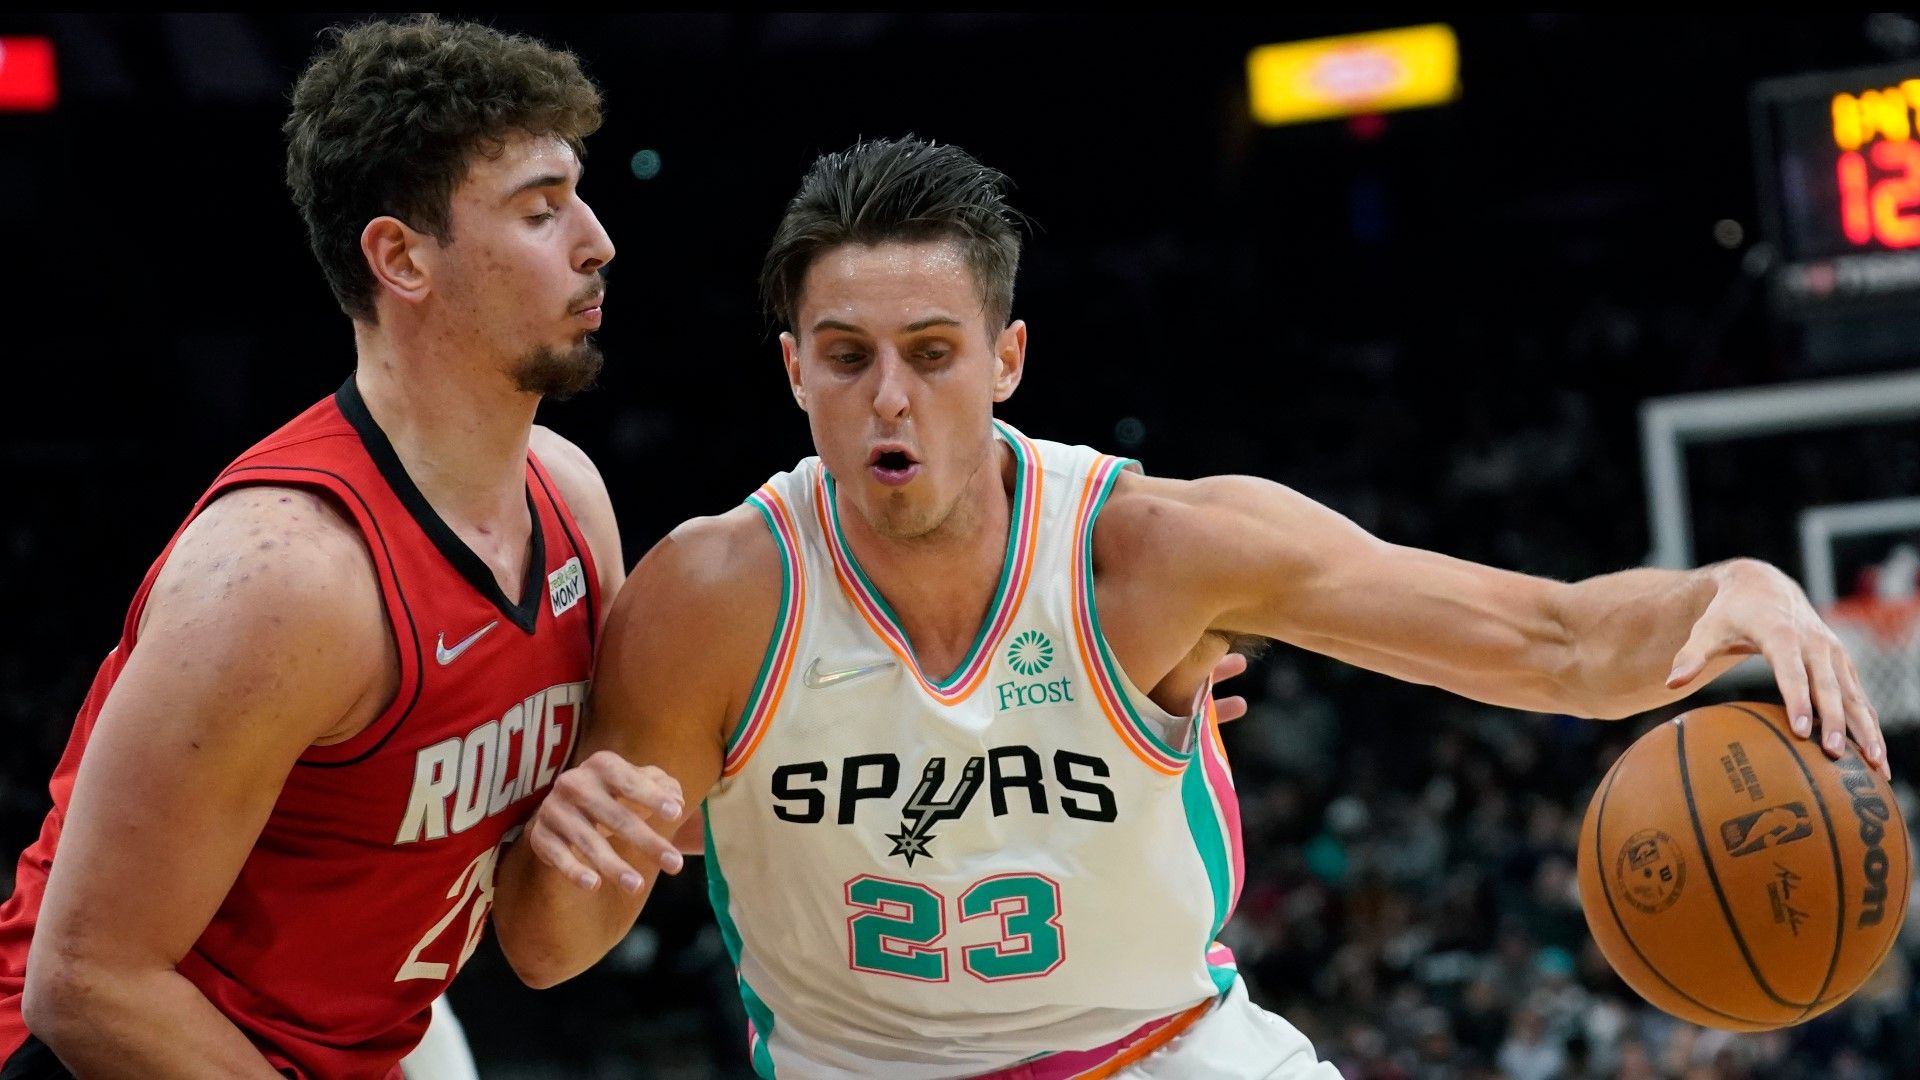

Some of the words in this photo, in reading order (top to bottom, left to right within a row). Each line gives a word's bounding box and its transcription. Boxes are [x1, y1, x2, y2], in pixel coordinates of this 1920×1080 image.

[996, 676, 1074, 711] Frost
[394, 680, 591, 845] ROCKET
[771, 745, 1118, 867] SPURS
[844, 872, 1066, 983] 23
